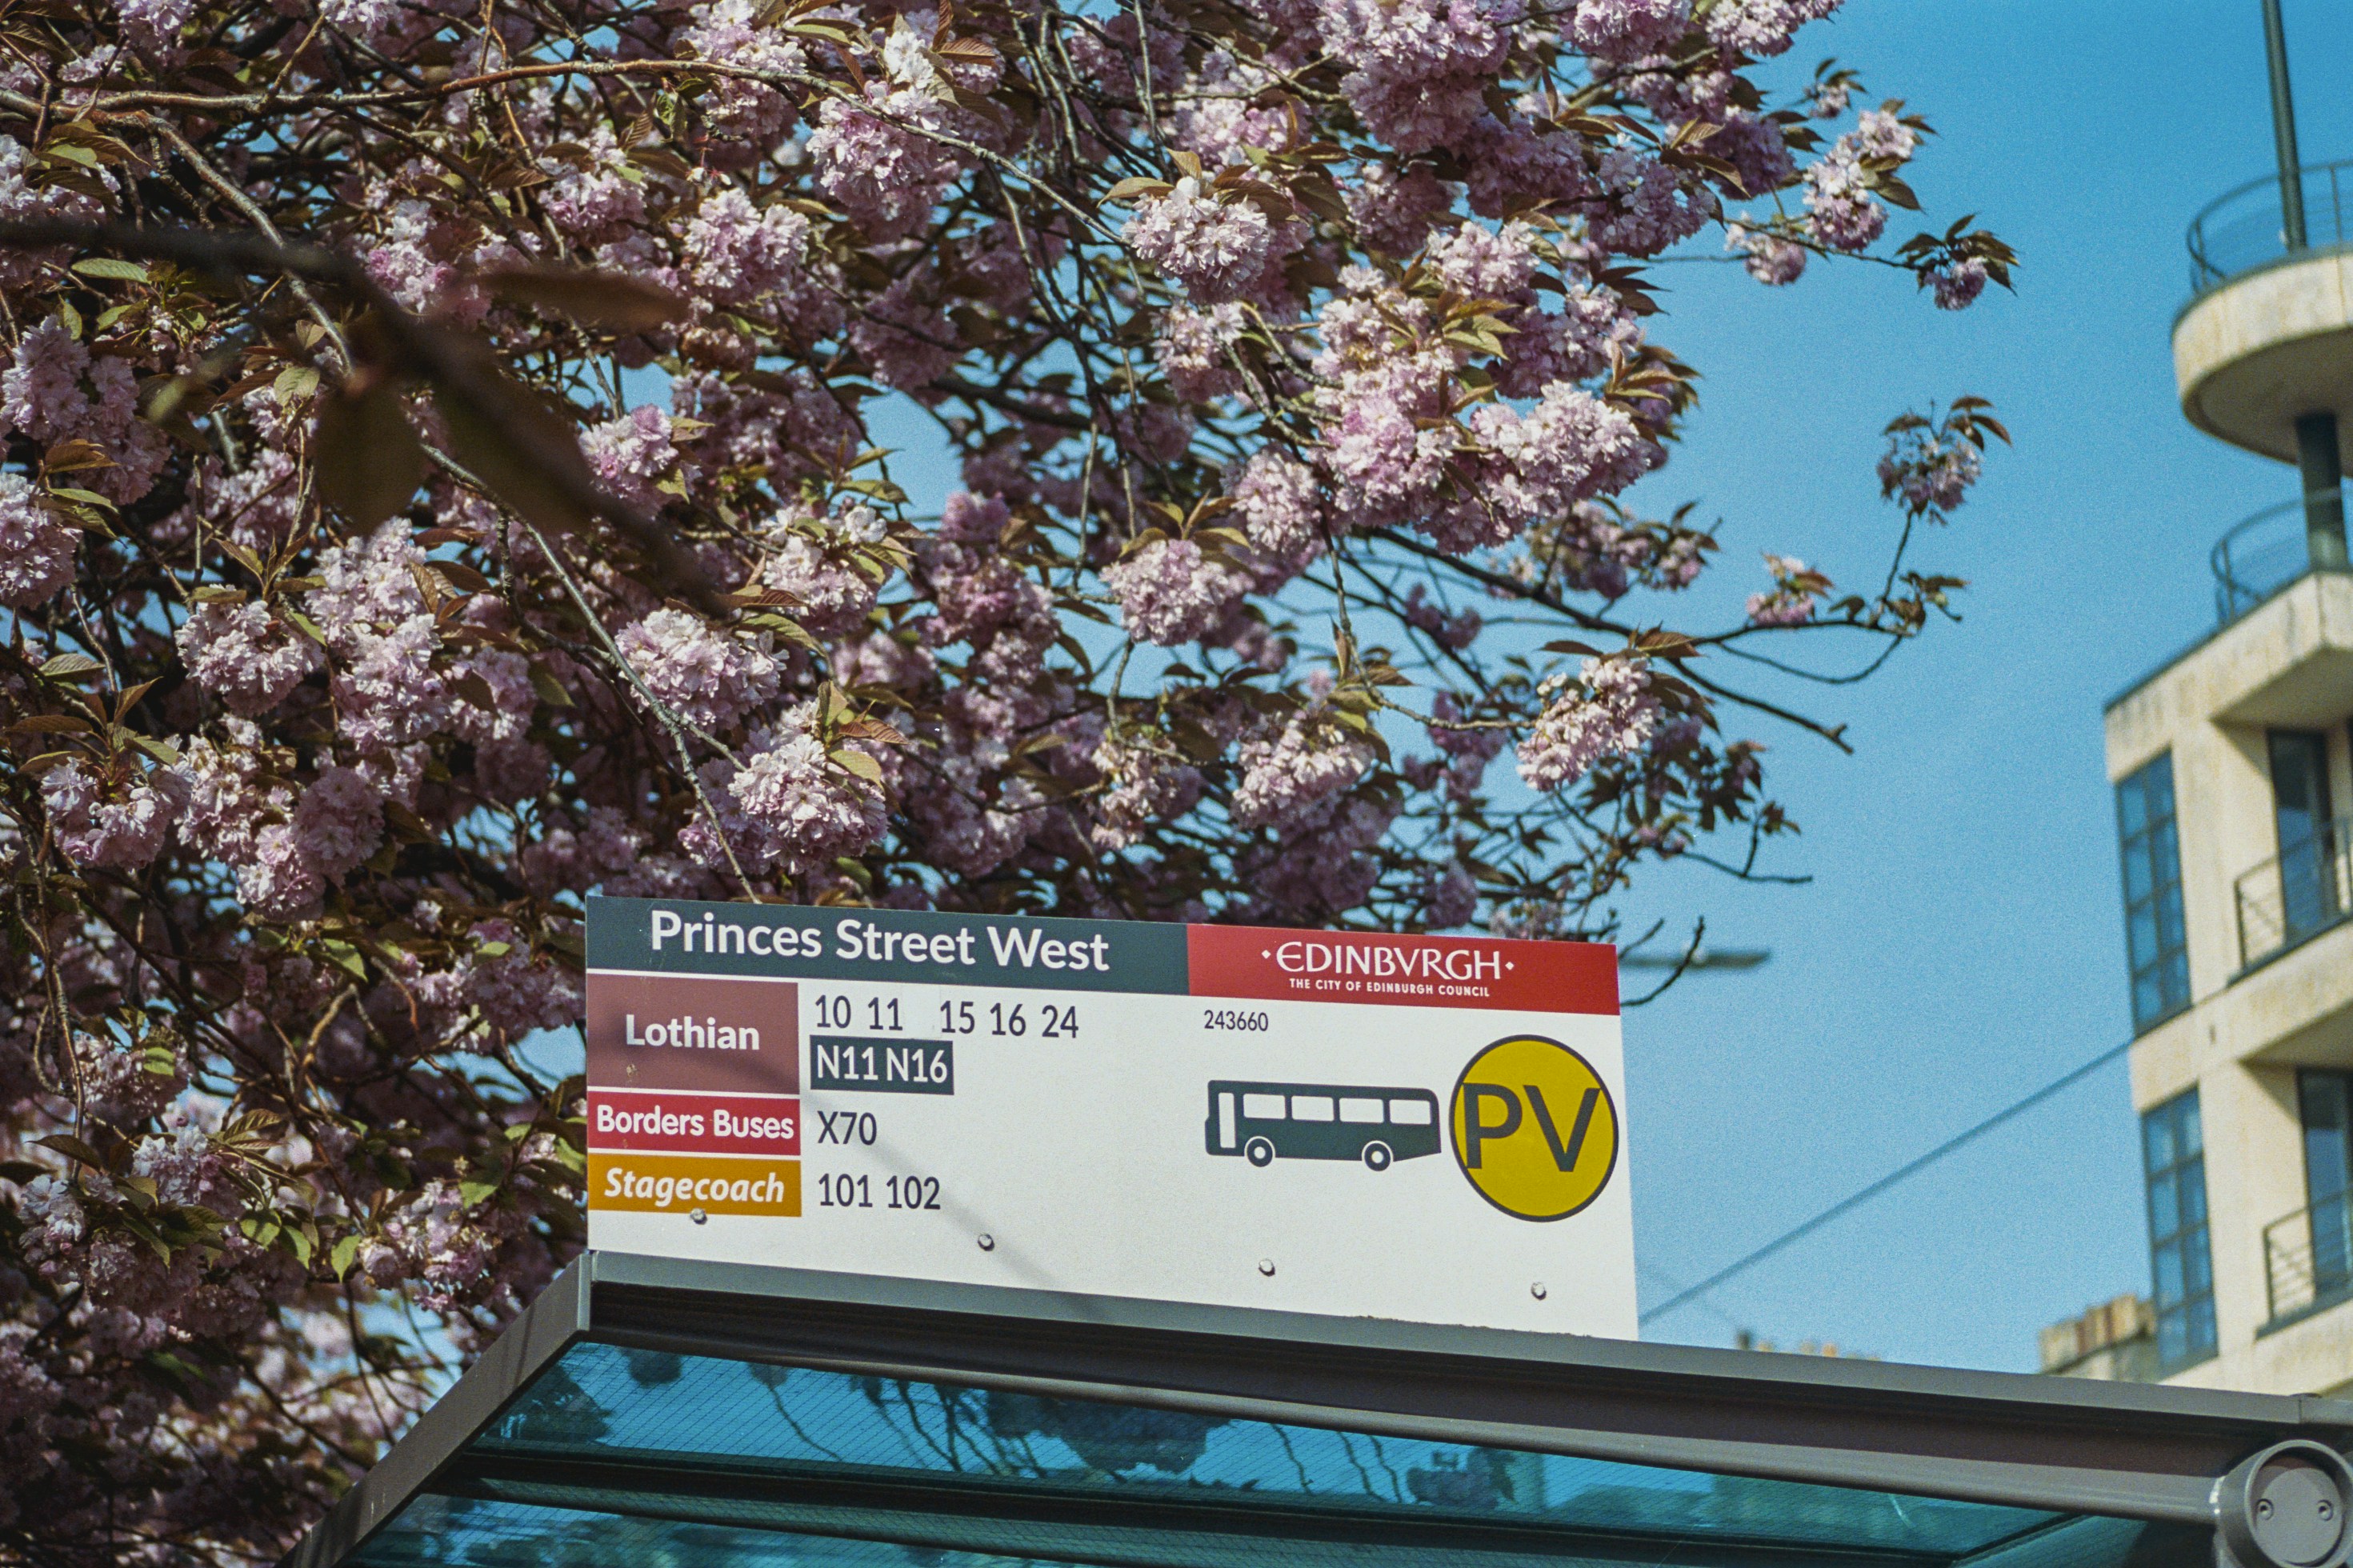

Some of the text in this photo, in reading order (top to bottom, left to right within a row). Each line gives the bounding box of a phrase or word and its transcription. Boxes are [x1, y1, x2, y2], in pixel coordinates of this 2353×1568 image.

[650, 910, 1110, 972] Princes Street West
[1289, 978, 1490, 997] THE CITY OF EDINBURGH COUNCIL
[626, 1014, 760, 1050] Lothian
[815, 994, 1078, 1039] 10 11 15 16 24
[1204, 1010, 1268, 1032] 243660
[817, 1044, 949, 1084] N11 N16
[597, 1105, 794, 1139] Borders Buses
[818, 1111, 877, 1146] X70
[1463, 1082, 1601, 1172] PV
[604, 1168, 786, 1207] Stagecoach
[818, 1174, 941, 1210] 101 102
